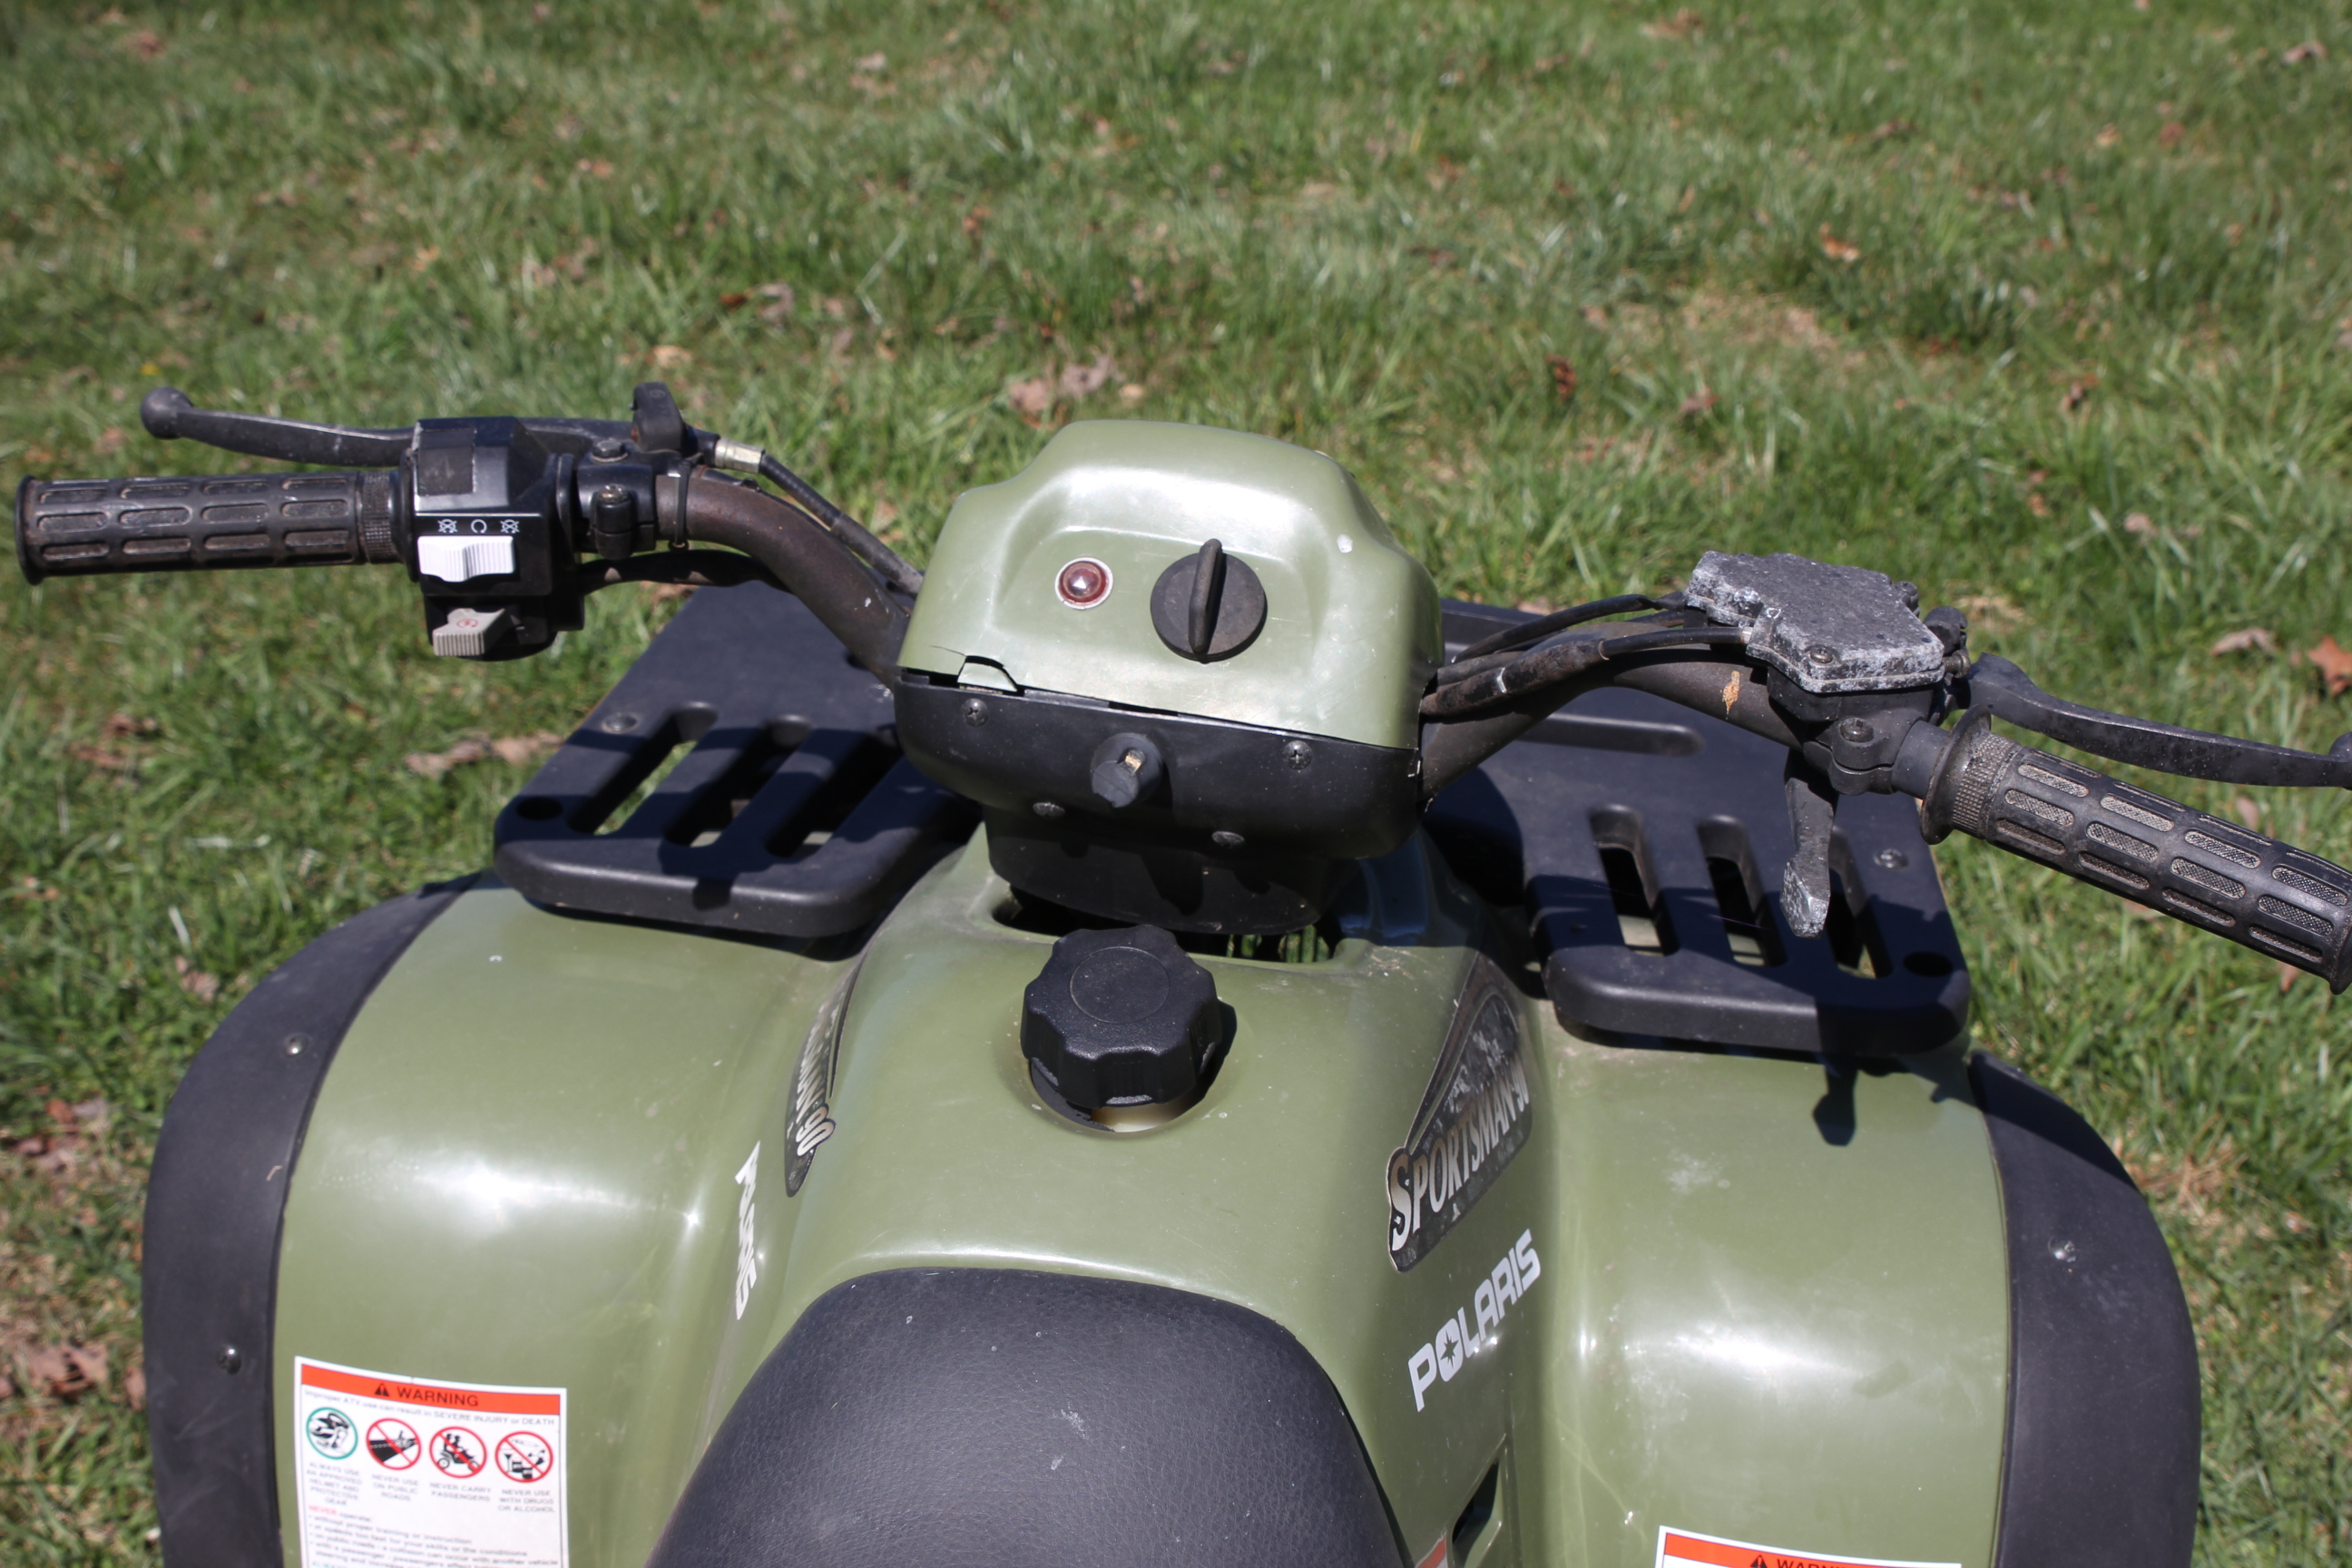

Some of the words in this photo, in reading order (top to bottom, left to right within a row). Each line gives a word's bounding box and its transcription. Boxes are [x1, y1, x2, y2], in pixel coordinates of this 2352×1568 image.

[1390, 1076, 1517, 1251] SPORTSMAN
[1407, 1228, 1542, 1412] POLARIS
[397, 1387, 479, 1406] WARNING
[343, 1397, 361, 1406] ATV
[434, 1410, 471, 1421] SEVERE
[474, 1416, 509, 1424] INJURY
[522, 1417, 555, 1426] DEATH
[371, 1474, 400, 1483] NEVER
[402, 1477, 419, 1486] USE
[429, 1482, 459, 1490] NEVER
[461, 1485, 492, 1494] CARRY
[431, 1490, 491, 1502] PASSENGERS
[514, 1504, 555, 1513] ALCOHOL
